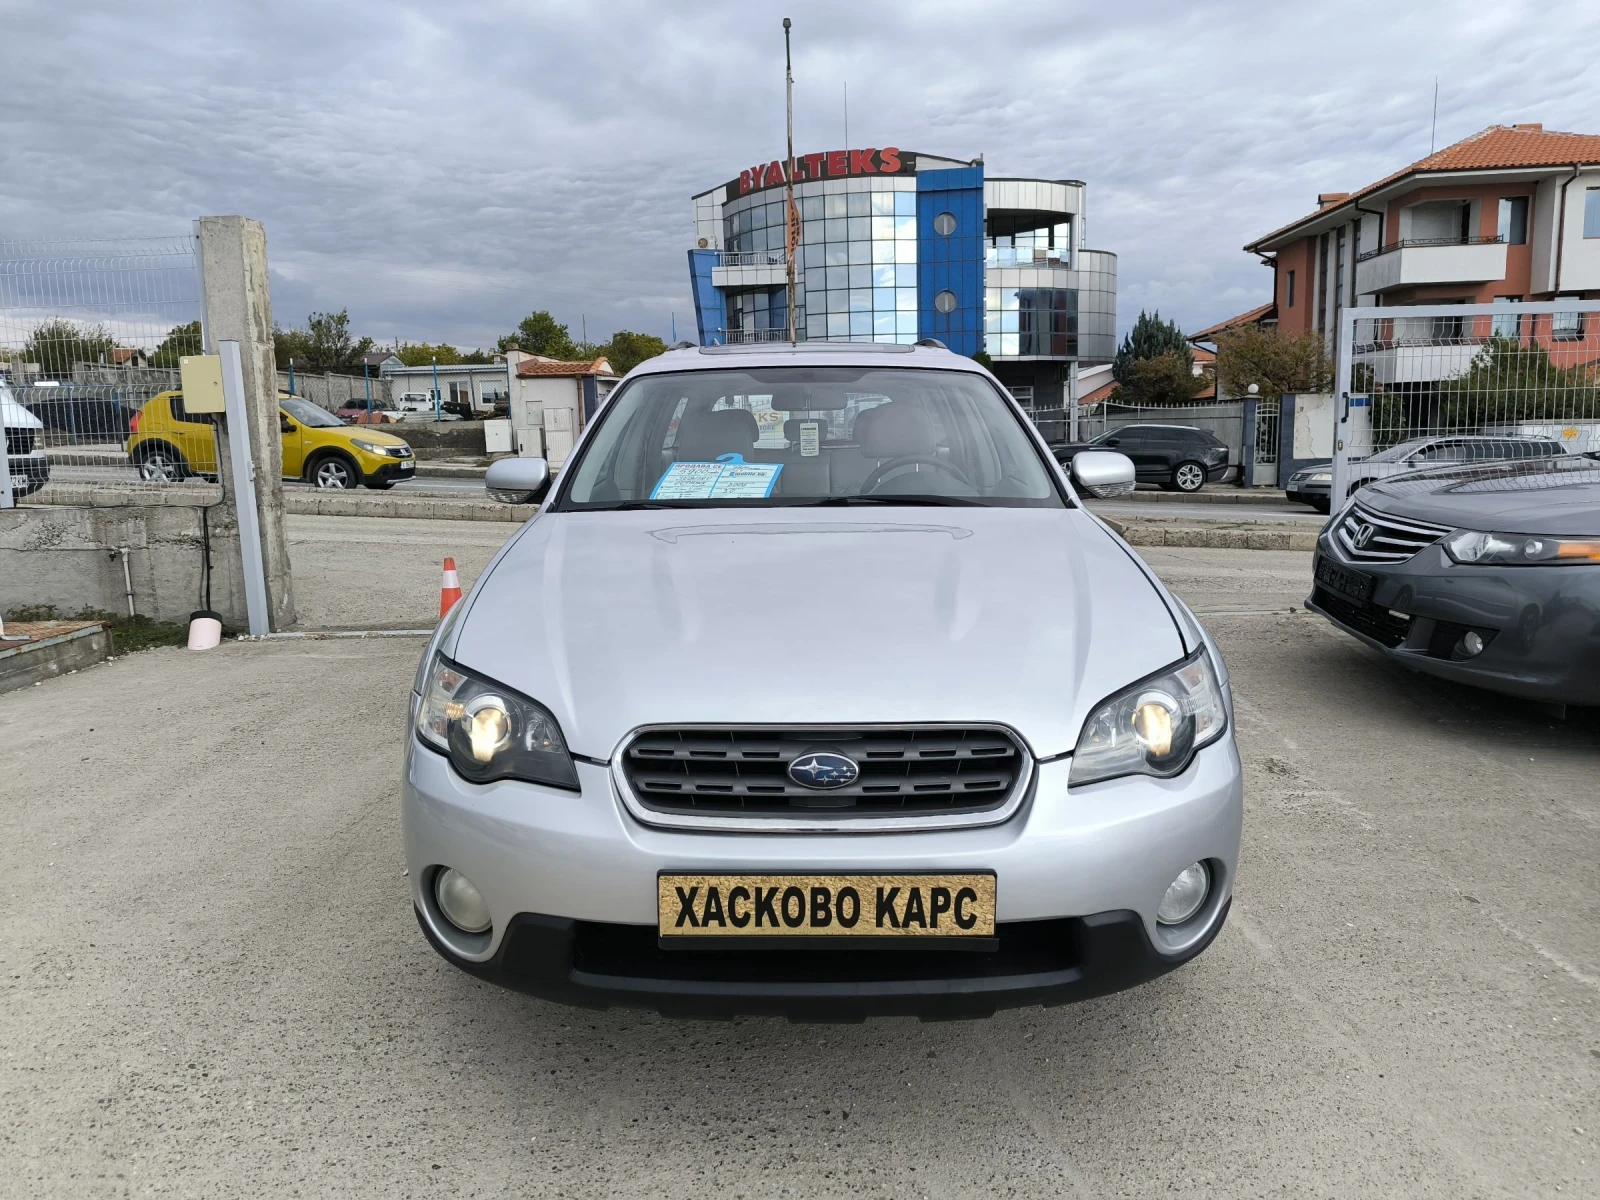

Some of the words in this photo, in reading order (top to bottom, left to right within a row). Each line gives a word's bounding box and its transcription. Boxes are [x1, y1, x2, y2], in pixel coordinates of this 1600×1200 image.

[740, 147, 901, 195] BYALTEKS
[674, 886, 861, 929] ХАСКОВО
[875, 886, 978, 930] КАРС
